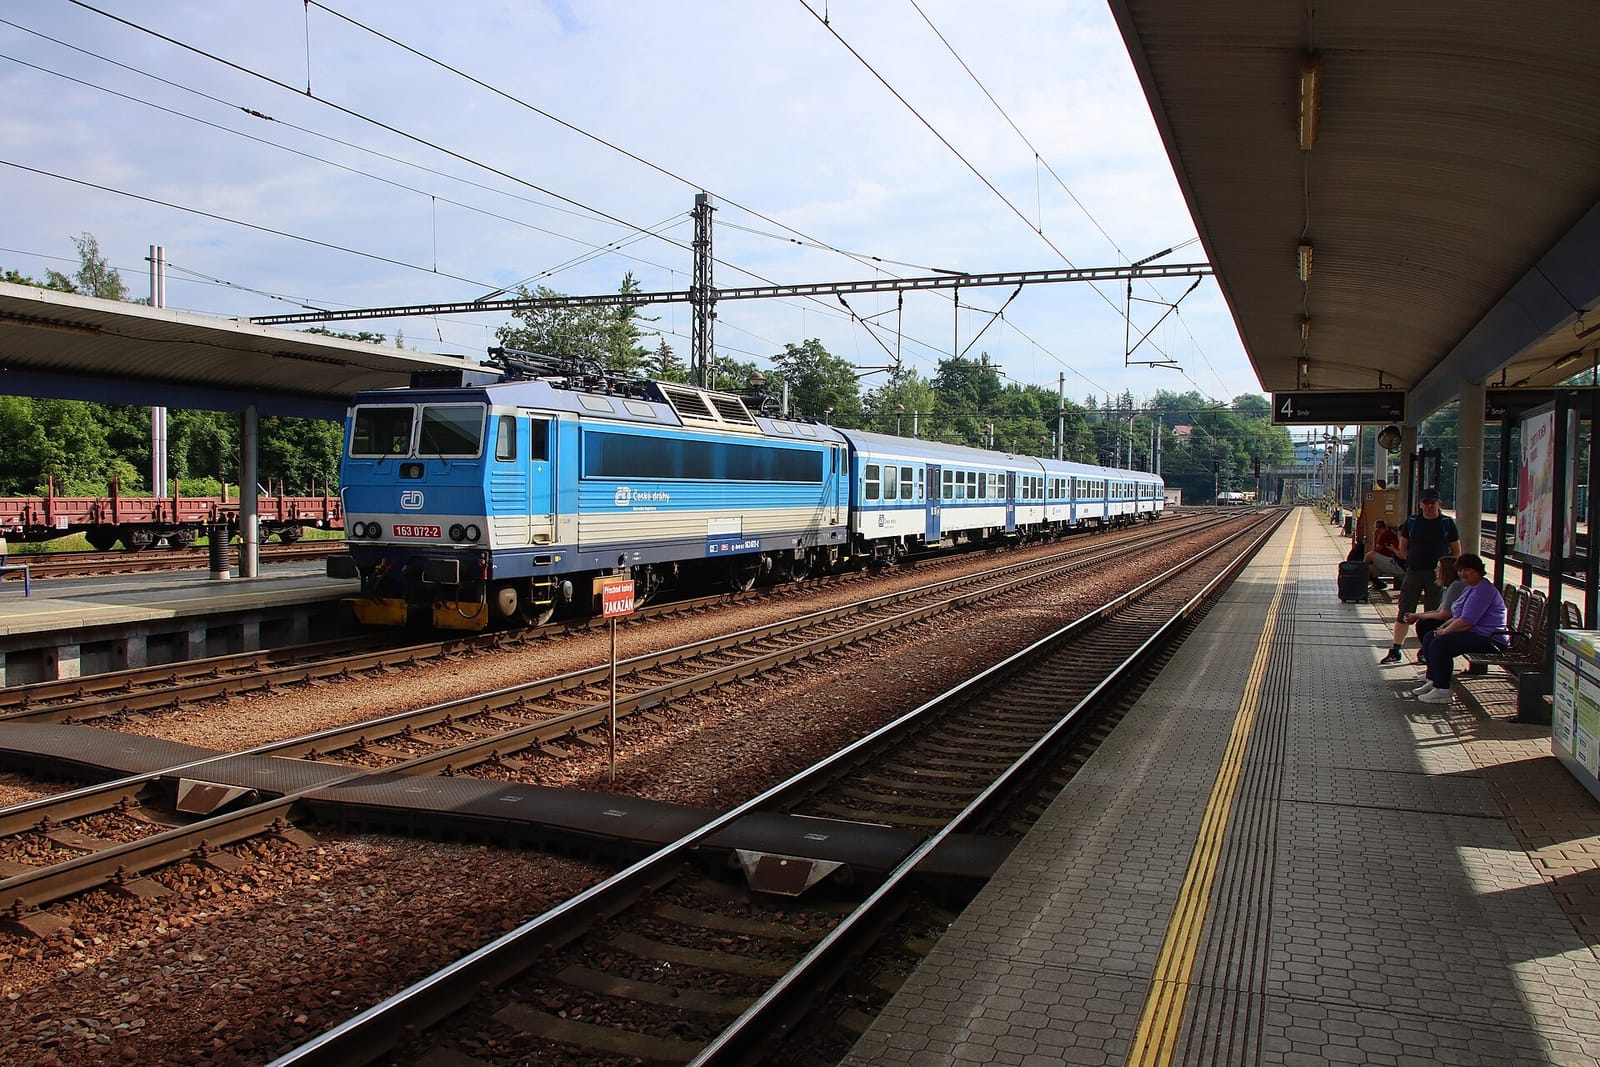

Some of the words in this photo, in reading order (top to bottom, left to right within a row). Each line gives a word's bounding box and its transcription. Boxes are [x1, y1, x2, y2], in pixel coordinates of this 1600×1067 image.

[1280, 398, 1294, 418] 4
[397, 526, 412, 536] 163
[414, 526, 439, 537] 072-2
[604, 595, 634, 614] ZAKAZÁN
